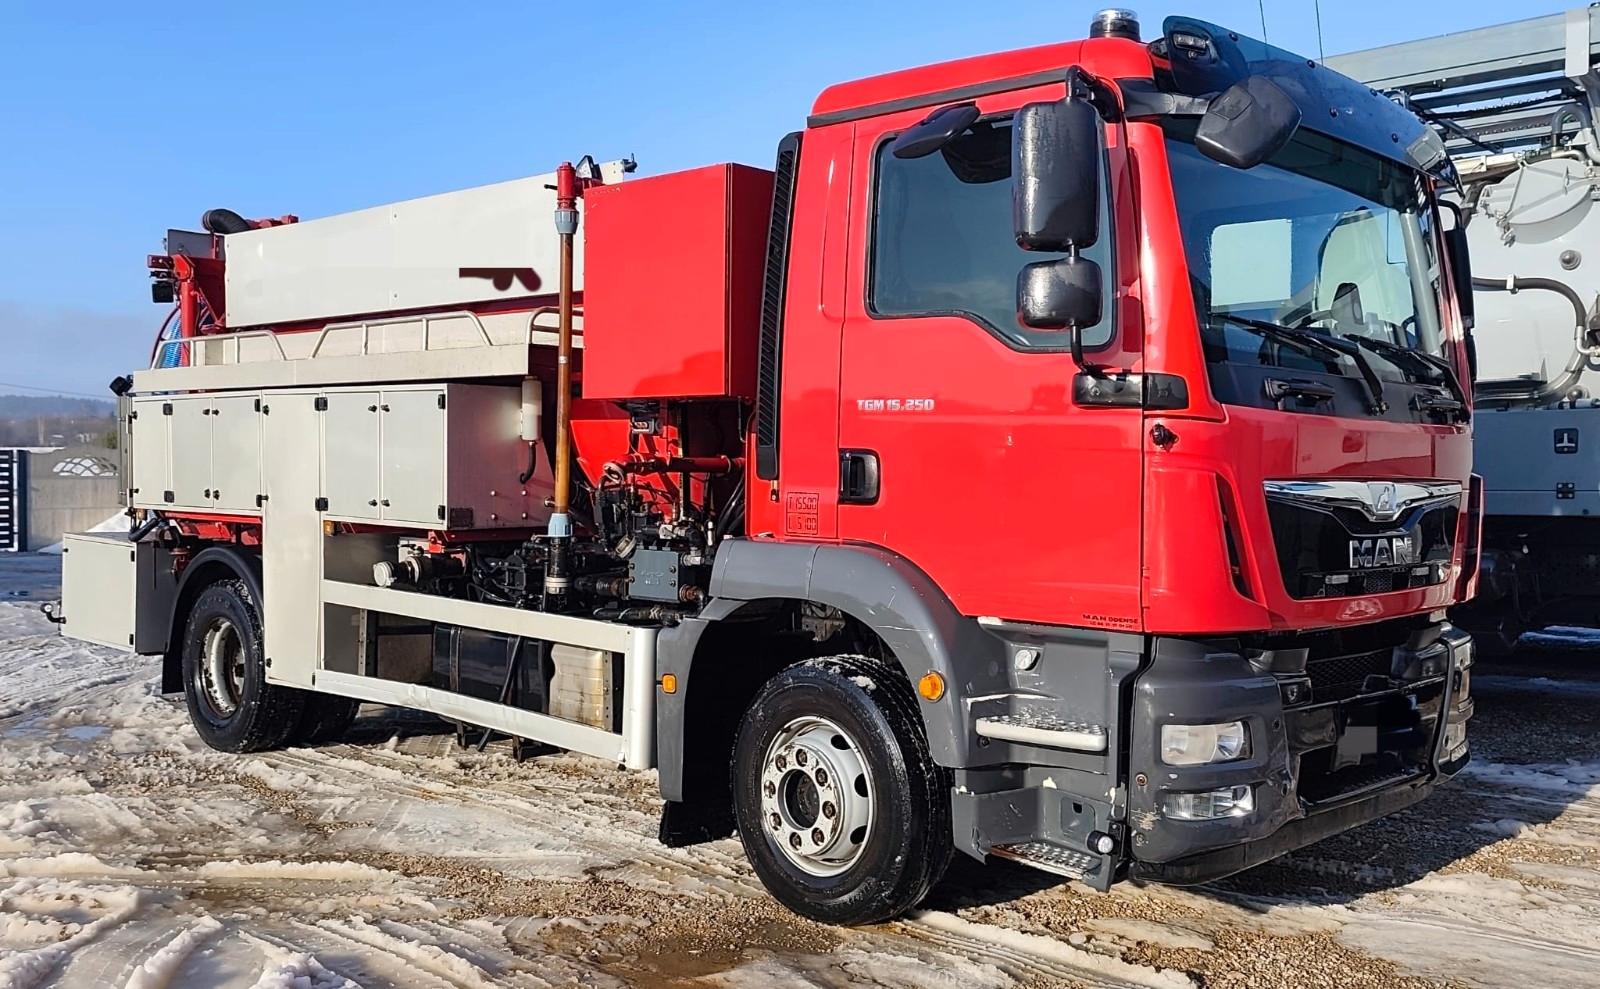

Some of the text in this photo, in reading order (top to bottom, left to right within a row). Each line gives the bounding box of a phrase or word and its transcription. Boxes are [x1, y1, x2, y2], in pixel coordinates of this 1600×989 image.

[857, 399, 935, 411] TGM 15.250
[1349, 537, 1413, 568] MAN
